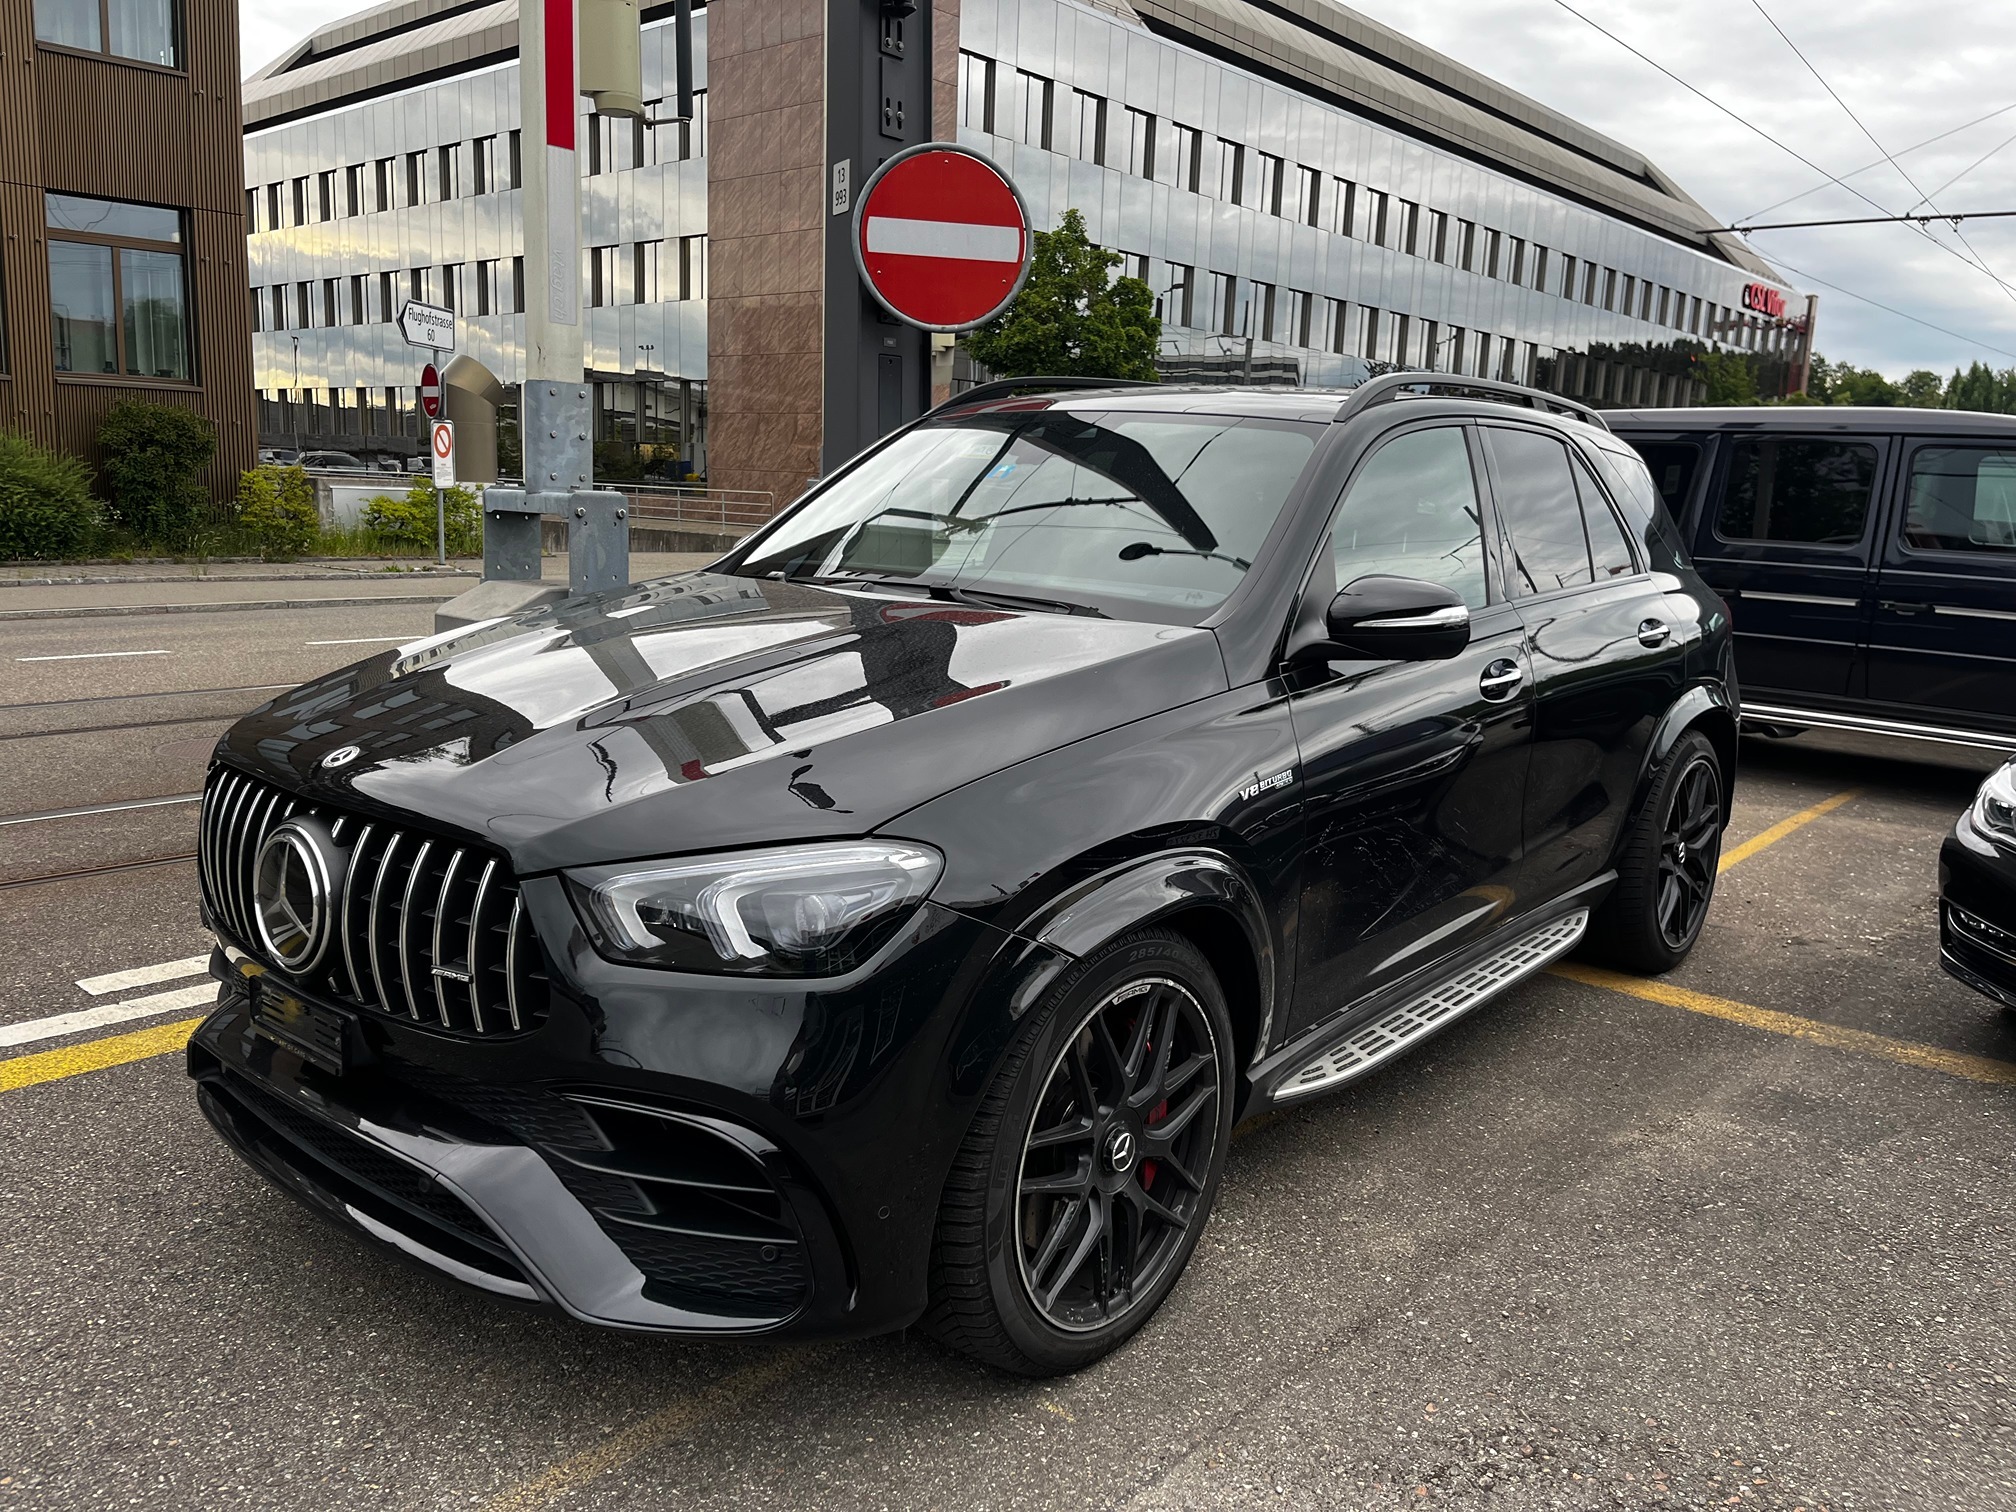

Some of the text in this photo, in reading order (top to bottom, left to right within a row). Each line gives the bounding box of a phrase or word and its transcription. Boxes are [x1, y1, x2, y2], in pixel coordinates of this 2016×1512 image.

[837, 167, 846, 184] 13
[835, 188, 847, 207] 993
[408, 307, 453, 330] Flughofstrasse
[427, 328, 436, 342] 60
[1239, 783, 1260, 801] V8
[1260, 769, 1292, 789] BITURBO
[1128, 946, 1179, 963] 285/40
